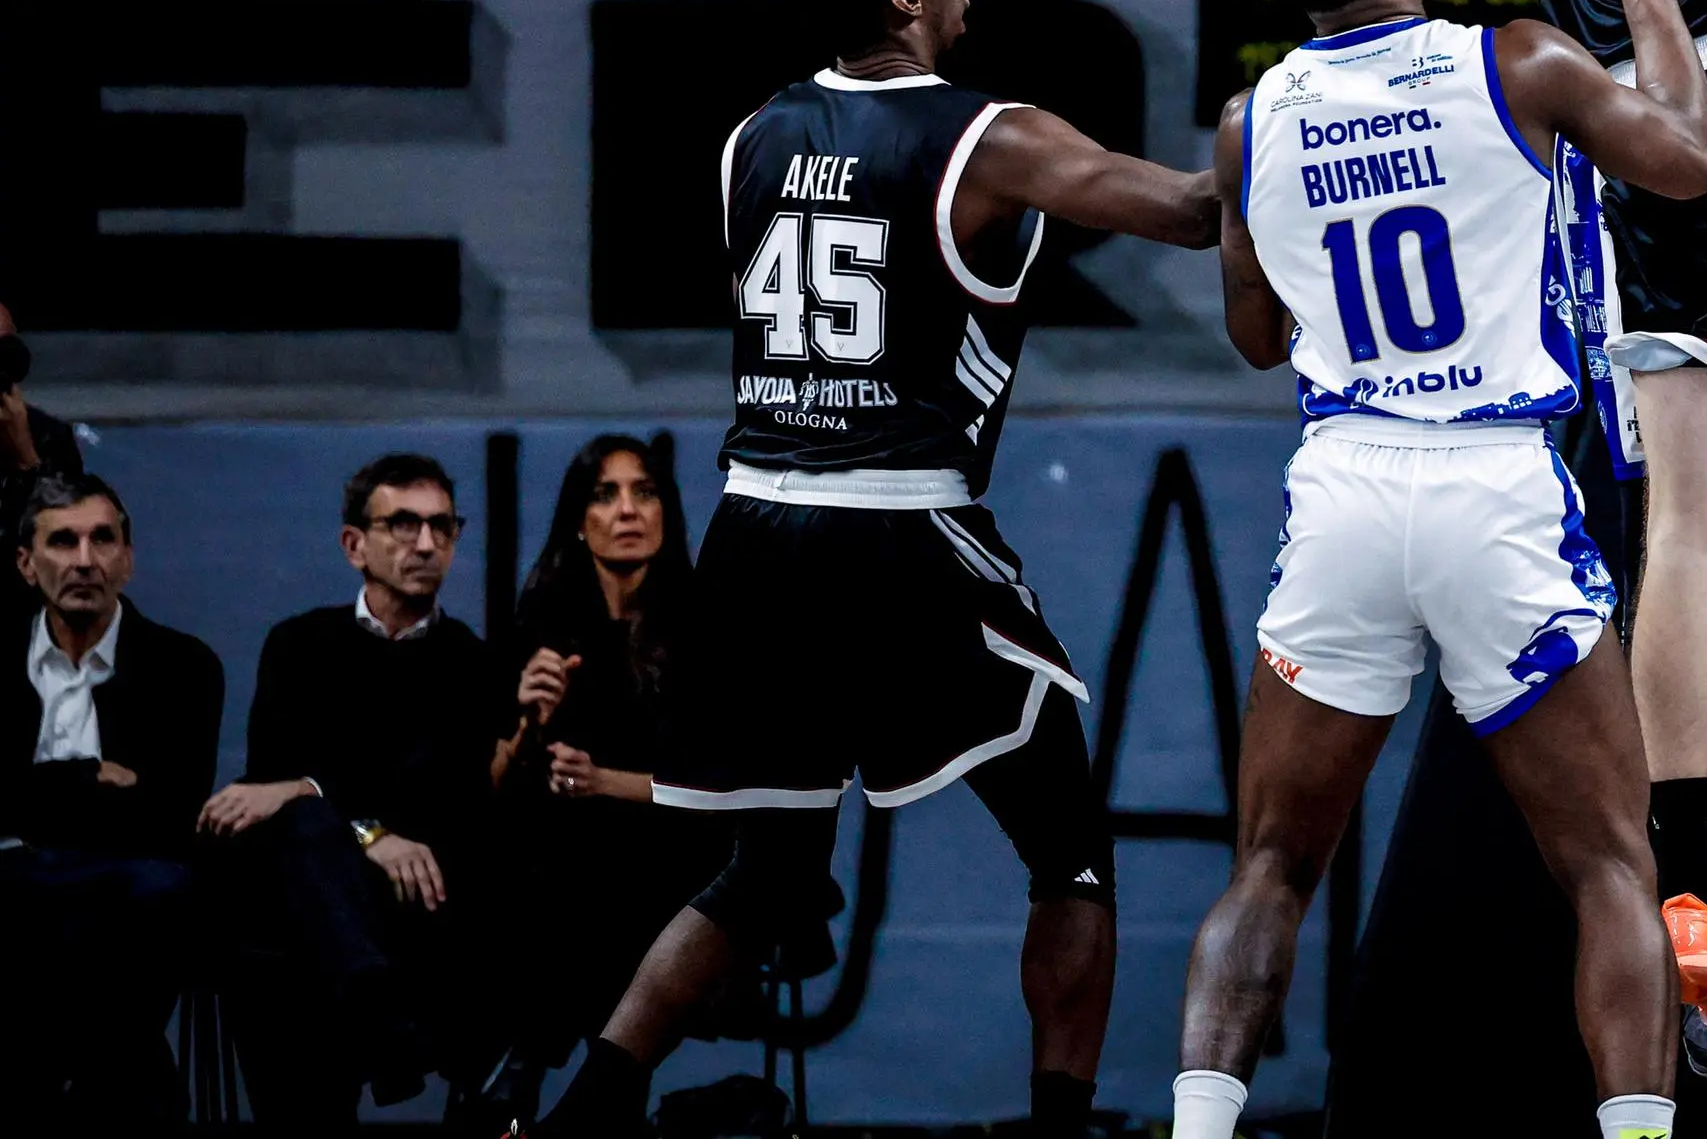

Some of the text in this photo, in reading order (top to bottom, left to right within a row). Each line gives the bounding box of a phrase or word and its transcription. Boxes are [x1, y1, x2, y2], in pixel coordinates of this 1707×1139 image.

[1388, 65, 1455, 88] BERNARDELLI
[1300, 108, 1442, 151] bonera.
[781, 155, 859, 202] AKELE
[1301, 145, 1446, 208] BURNELL
[738, 212, 890, 365] 45
[1320, 204, 1467, 364] 10
[737, 375, 797, 405] SAVOIA
[818, 378, 898, 408] HOTELS
[1382, 364, 1483, 398] inblu
[774, 410, 848, 430] OLOGNA
